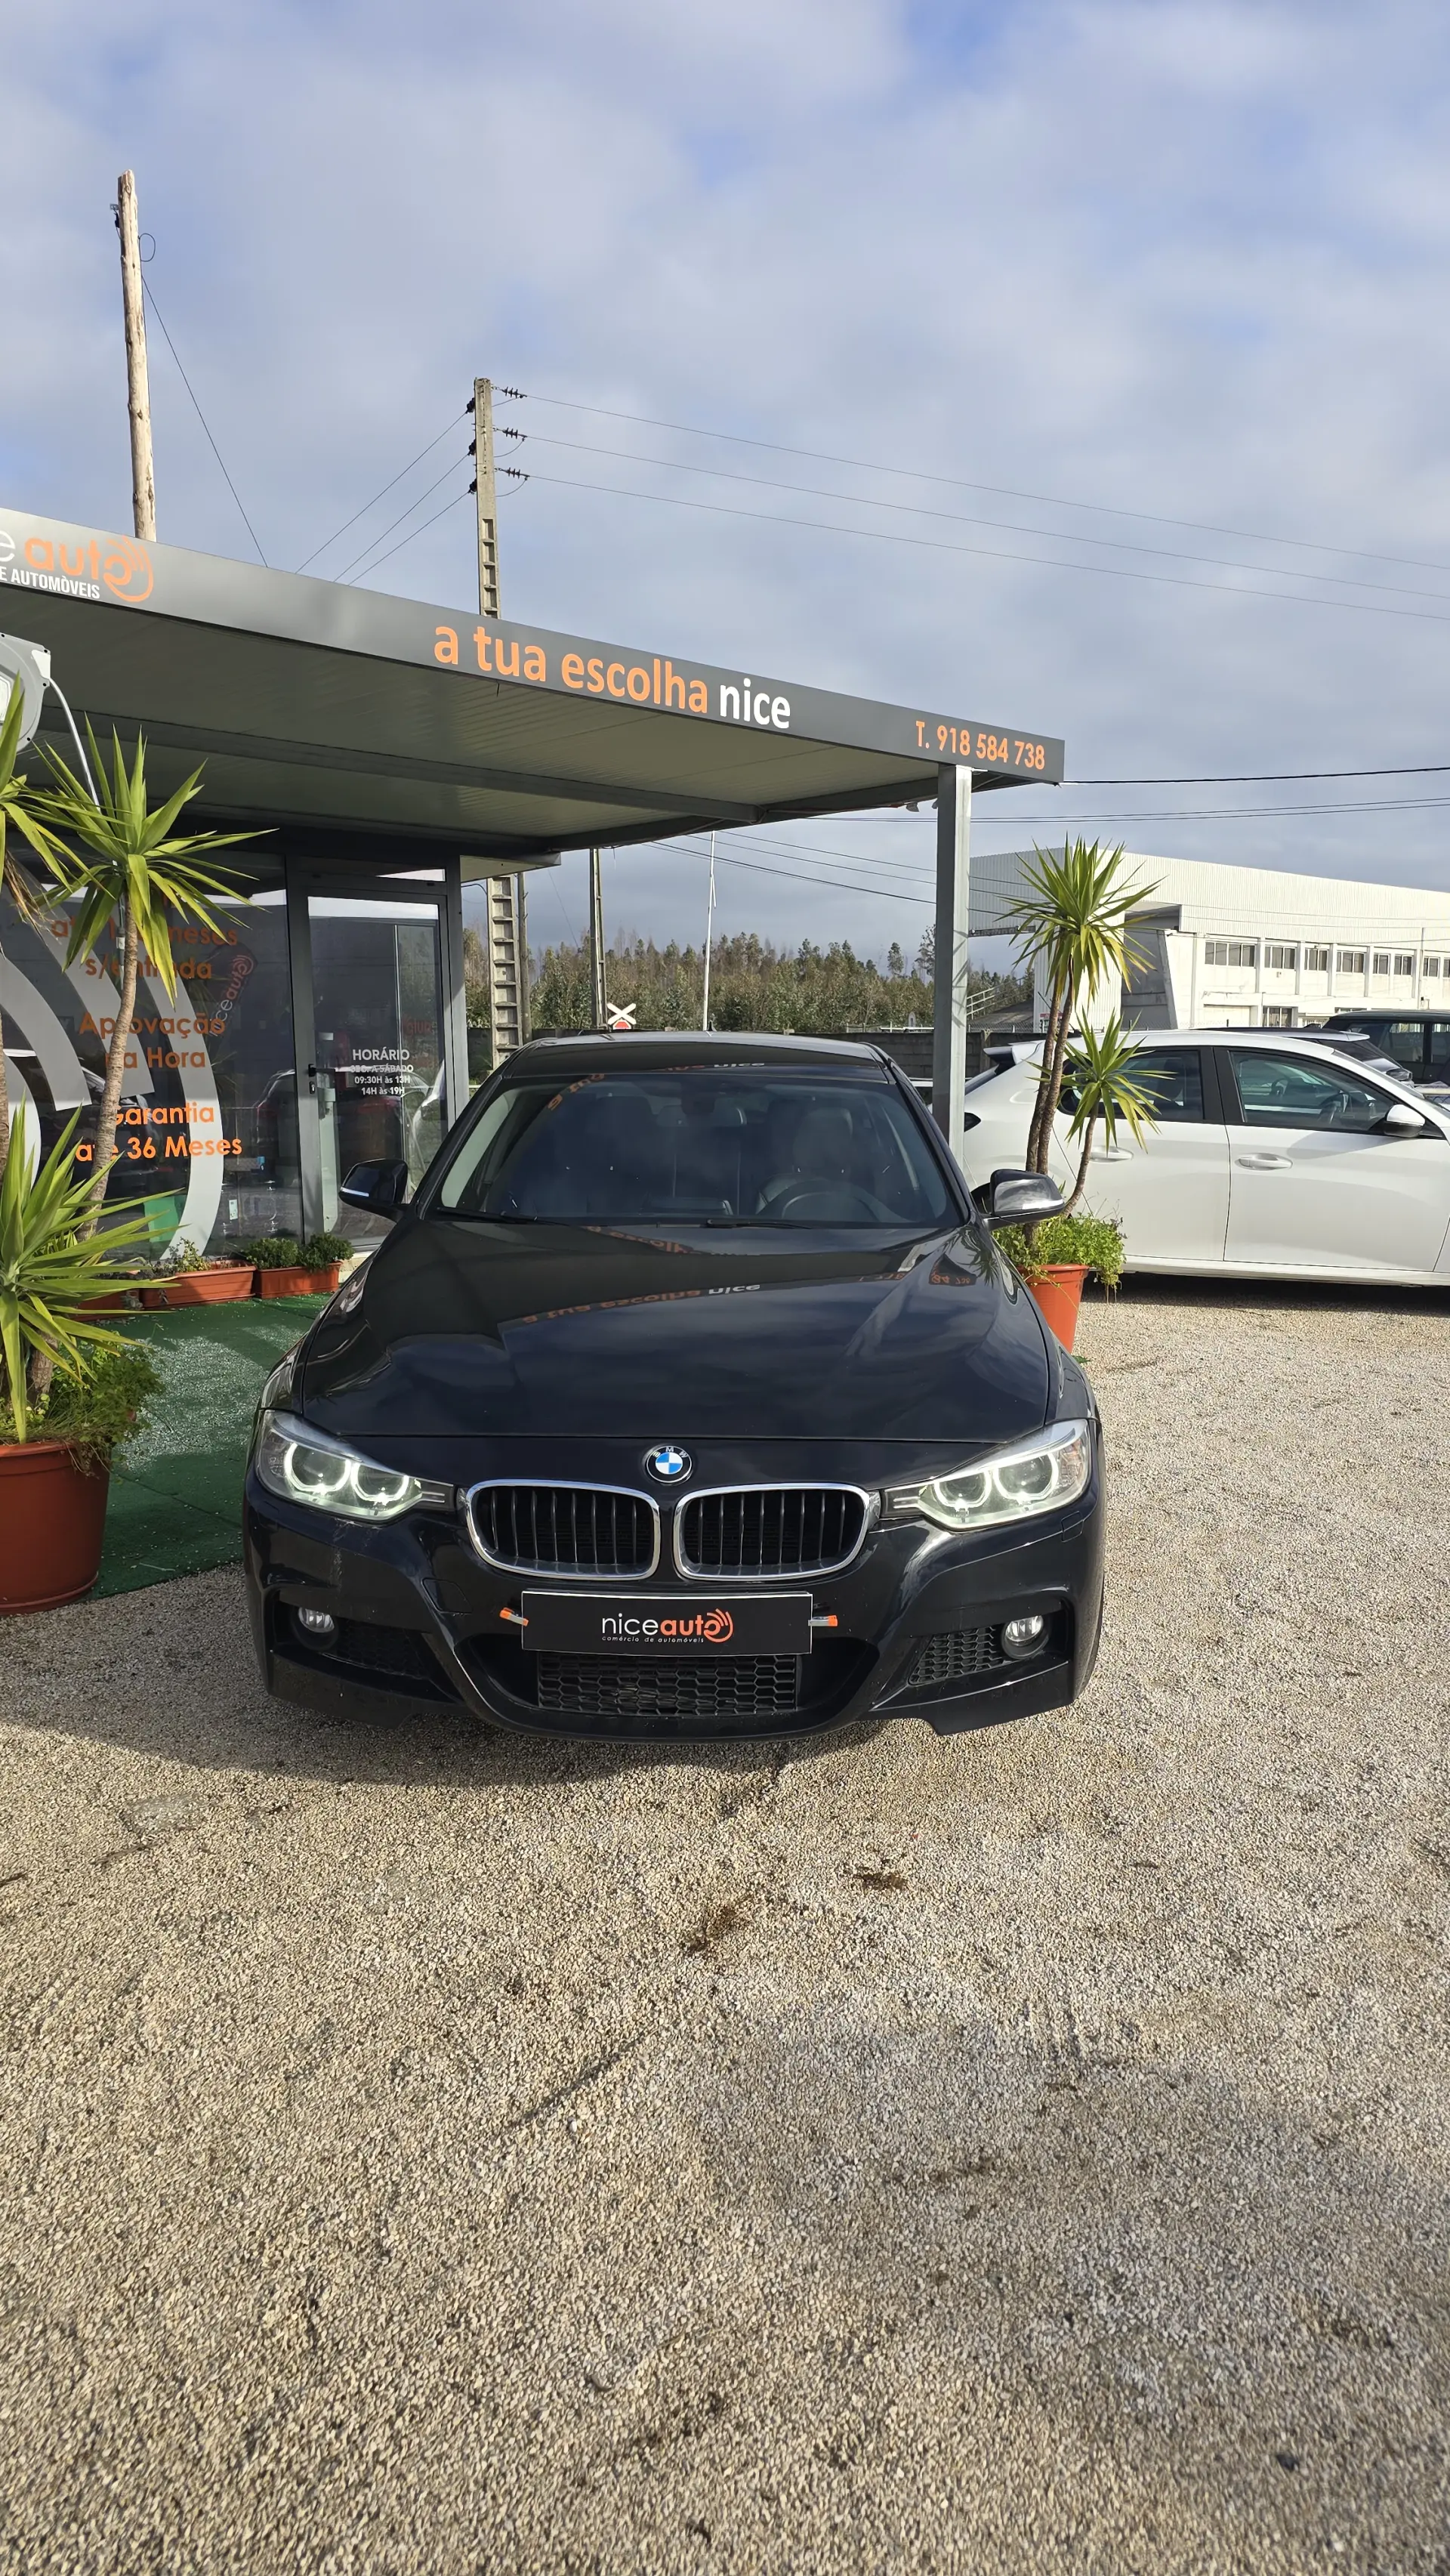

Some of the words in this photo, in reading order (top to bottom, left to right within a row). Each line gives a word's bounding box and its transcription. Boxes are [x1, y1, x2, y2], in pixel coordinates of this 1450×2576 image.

[0, 567, 7, 581] E
[434, 626, 459, 665] a
[473, 626, 546, 682] tua
[562, 653, 708, 713] escolha
[720, 678, 791, 729] nice
[915, 720, 930, 749] T.
[936, 725, 970, 756] 918
[976, 734, 1009, 763] 584
[1014, 740, 1045, 771] 738
[79, 1012, 226, 1039] Apovação
[147, 1046, 206, 1069] Hora
[352, 1046, 410, 1061] HORÁRIO
[354, 1076, 383, 1084] 09:30H
[361, 1087, 378, 1095] 14H
[390, 1086, 405, 1095] 19H
[126, 1137, 156, 1160] 36
[165, 1136, 242, 1158] Meses
